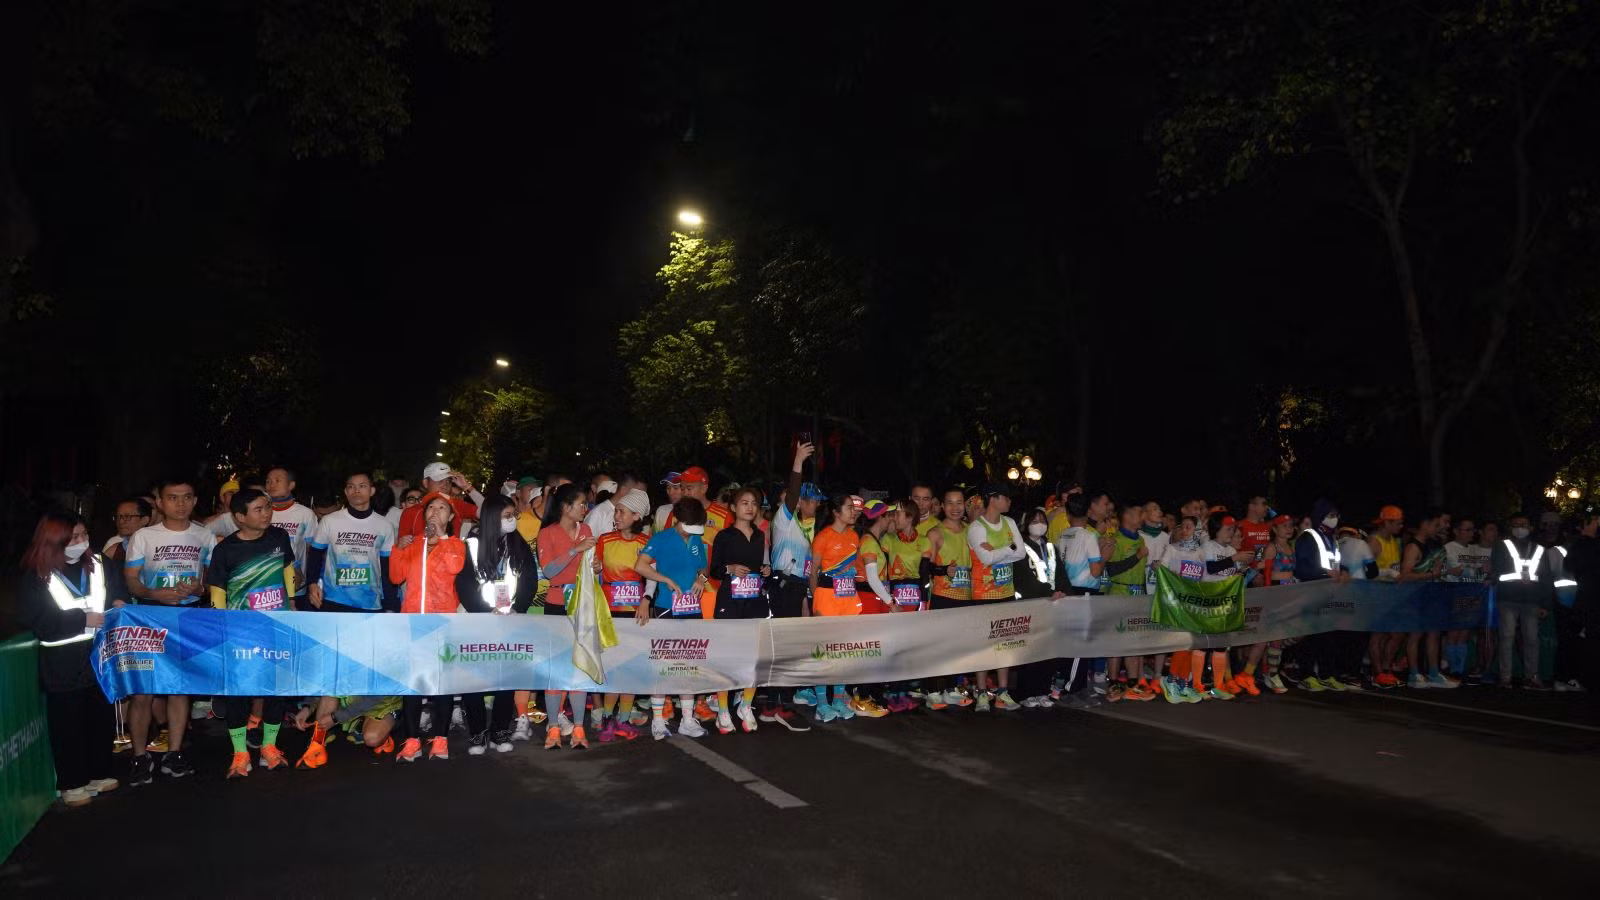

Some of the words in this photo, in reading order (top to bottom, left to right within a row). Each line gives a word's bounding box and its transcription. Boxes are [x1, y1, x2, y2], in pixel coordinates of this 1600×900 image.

[338, 532, 377, 541] VIETNAM
[155, 545, 201, 553] VIETNAM
[340, 568, 366, 579] 21679
[615, 585, 639, 597] 26298
[254, 589, 281, 605] 26003
[1178, 593, 1238, 607] HERBALIFE
[990, 615, 1031, 629] VIETNAM
[104, 626, 168, 644] IETNAM
[460, 643, 534, 653] HERBALIFE
[650, 639, 710, 649] VIETNAM
[825, 641, 881, 652] HERBALIFE
[263, 648, 291, 660] true
[460, 652, 534, 662] NUTRITION
[826, 649, 882, 659] NUTRITION
